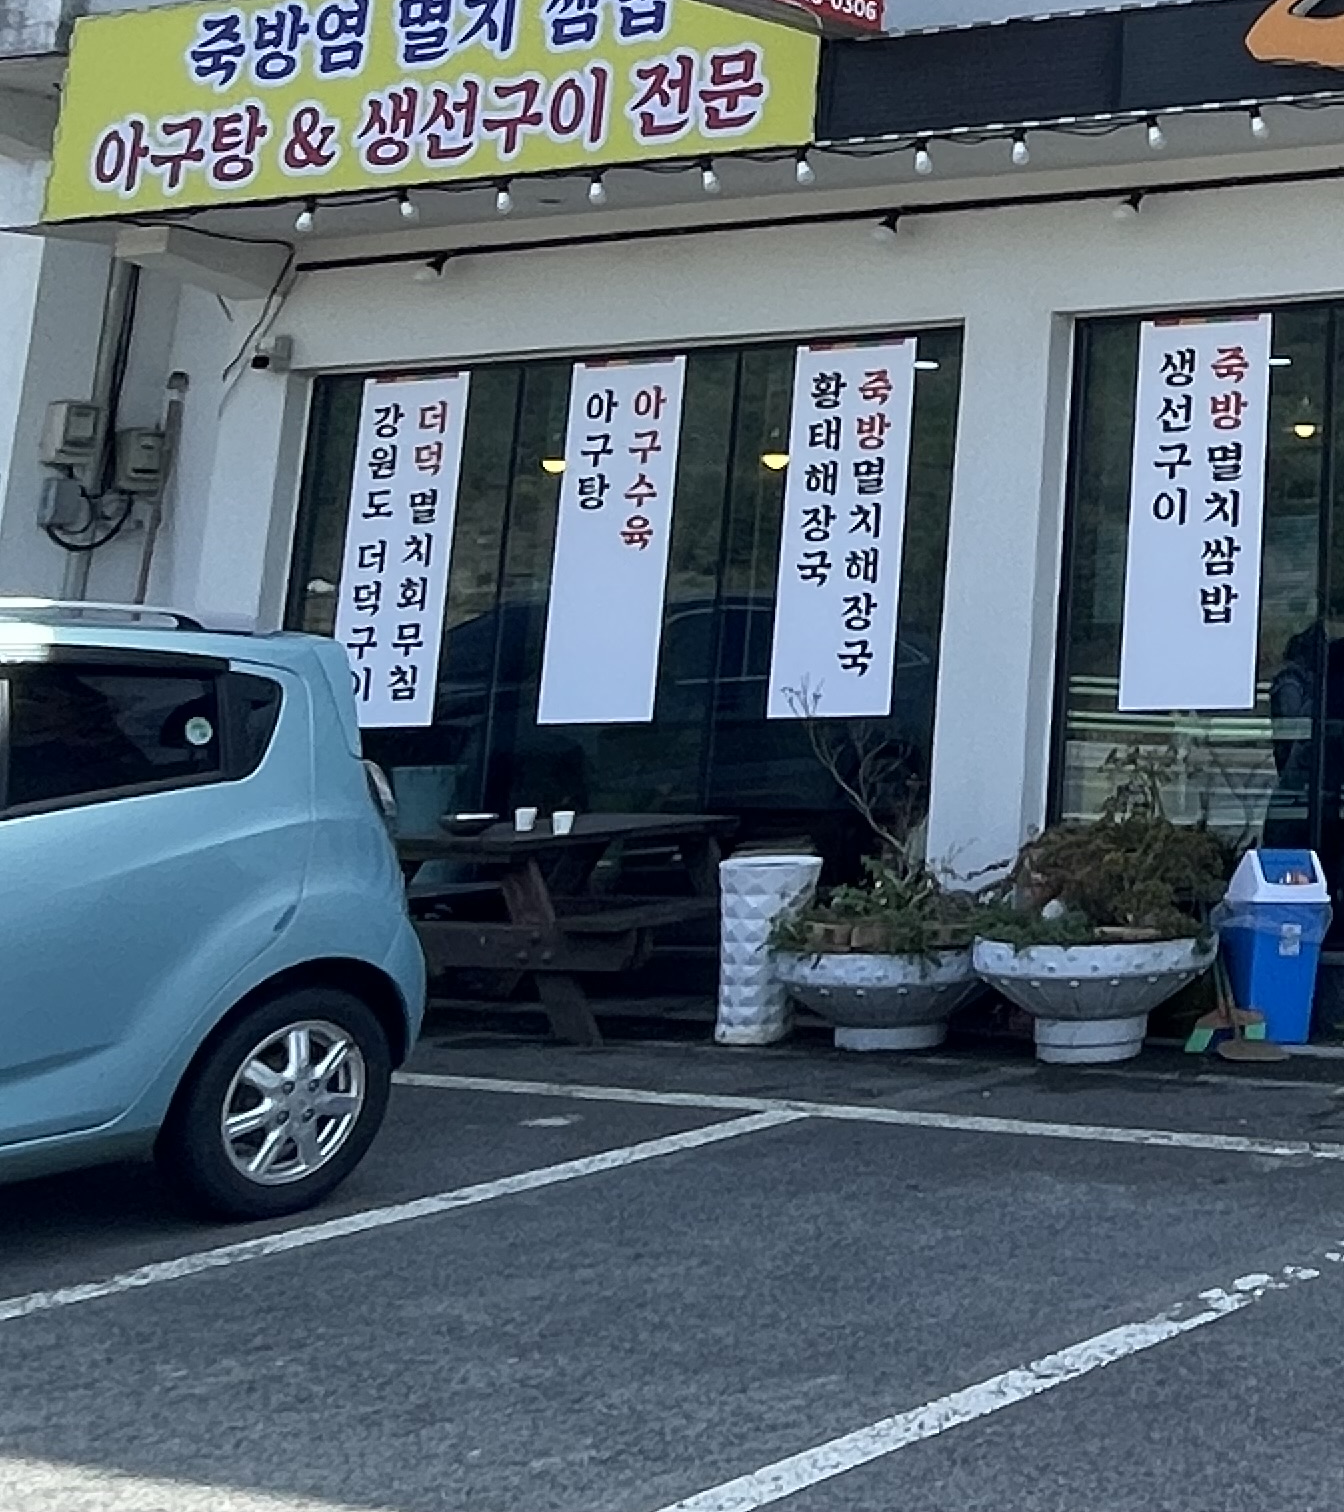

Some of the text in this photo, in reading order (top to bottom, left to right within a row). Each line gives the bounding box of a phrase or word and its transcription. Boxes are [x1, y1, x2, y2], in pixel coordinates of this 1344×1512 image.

[94, 49, 764, 191] 아구탕 & 생선구이 전문
[362, 404, 406, 520] 강원도
[577, 389, 619, 509] 아구탕
[620, 385, 667, 550] 아구수육
[797, 371, 847, 586] 황태해장국
[837, 370, 893, 676] 죽방멸치해장국
[1152, 348, 1196, 527] 생선구이
[1199, 345, 1249, 625] 죽방멸치쌈밥
